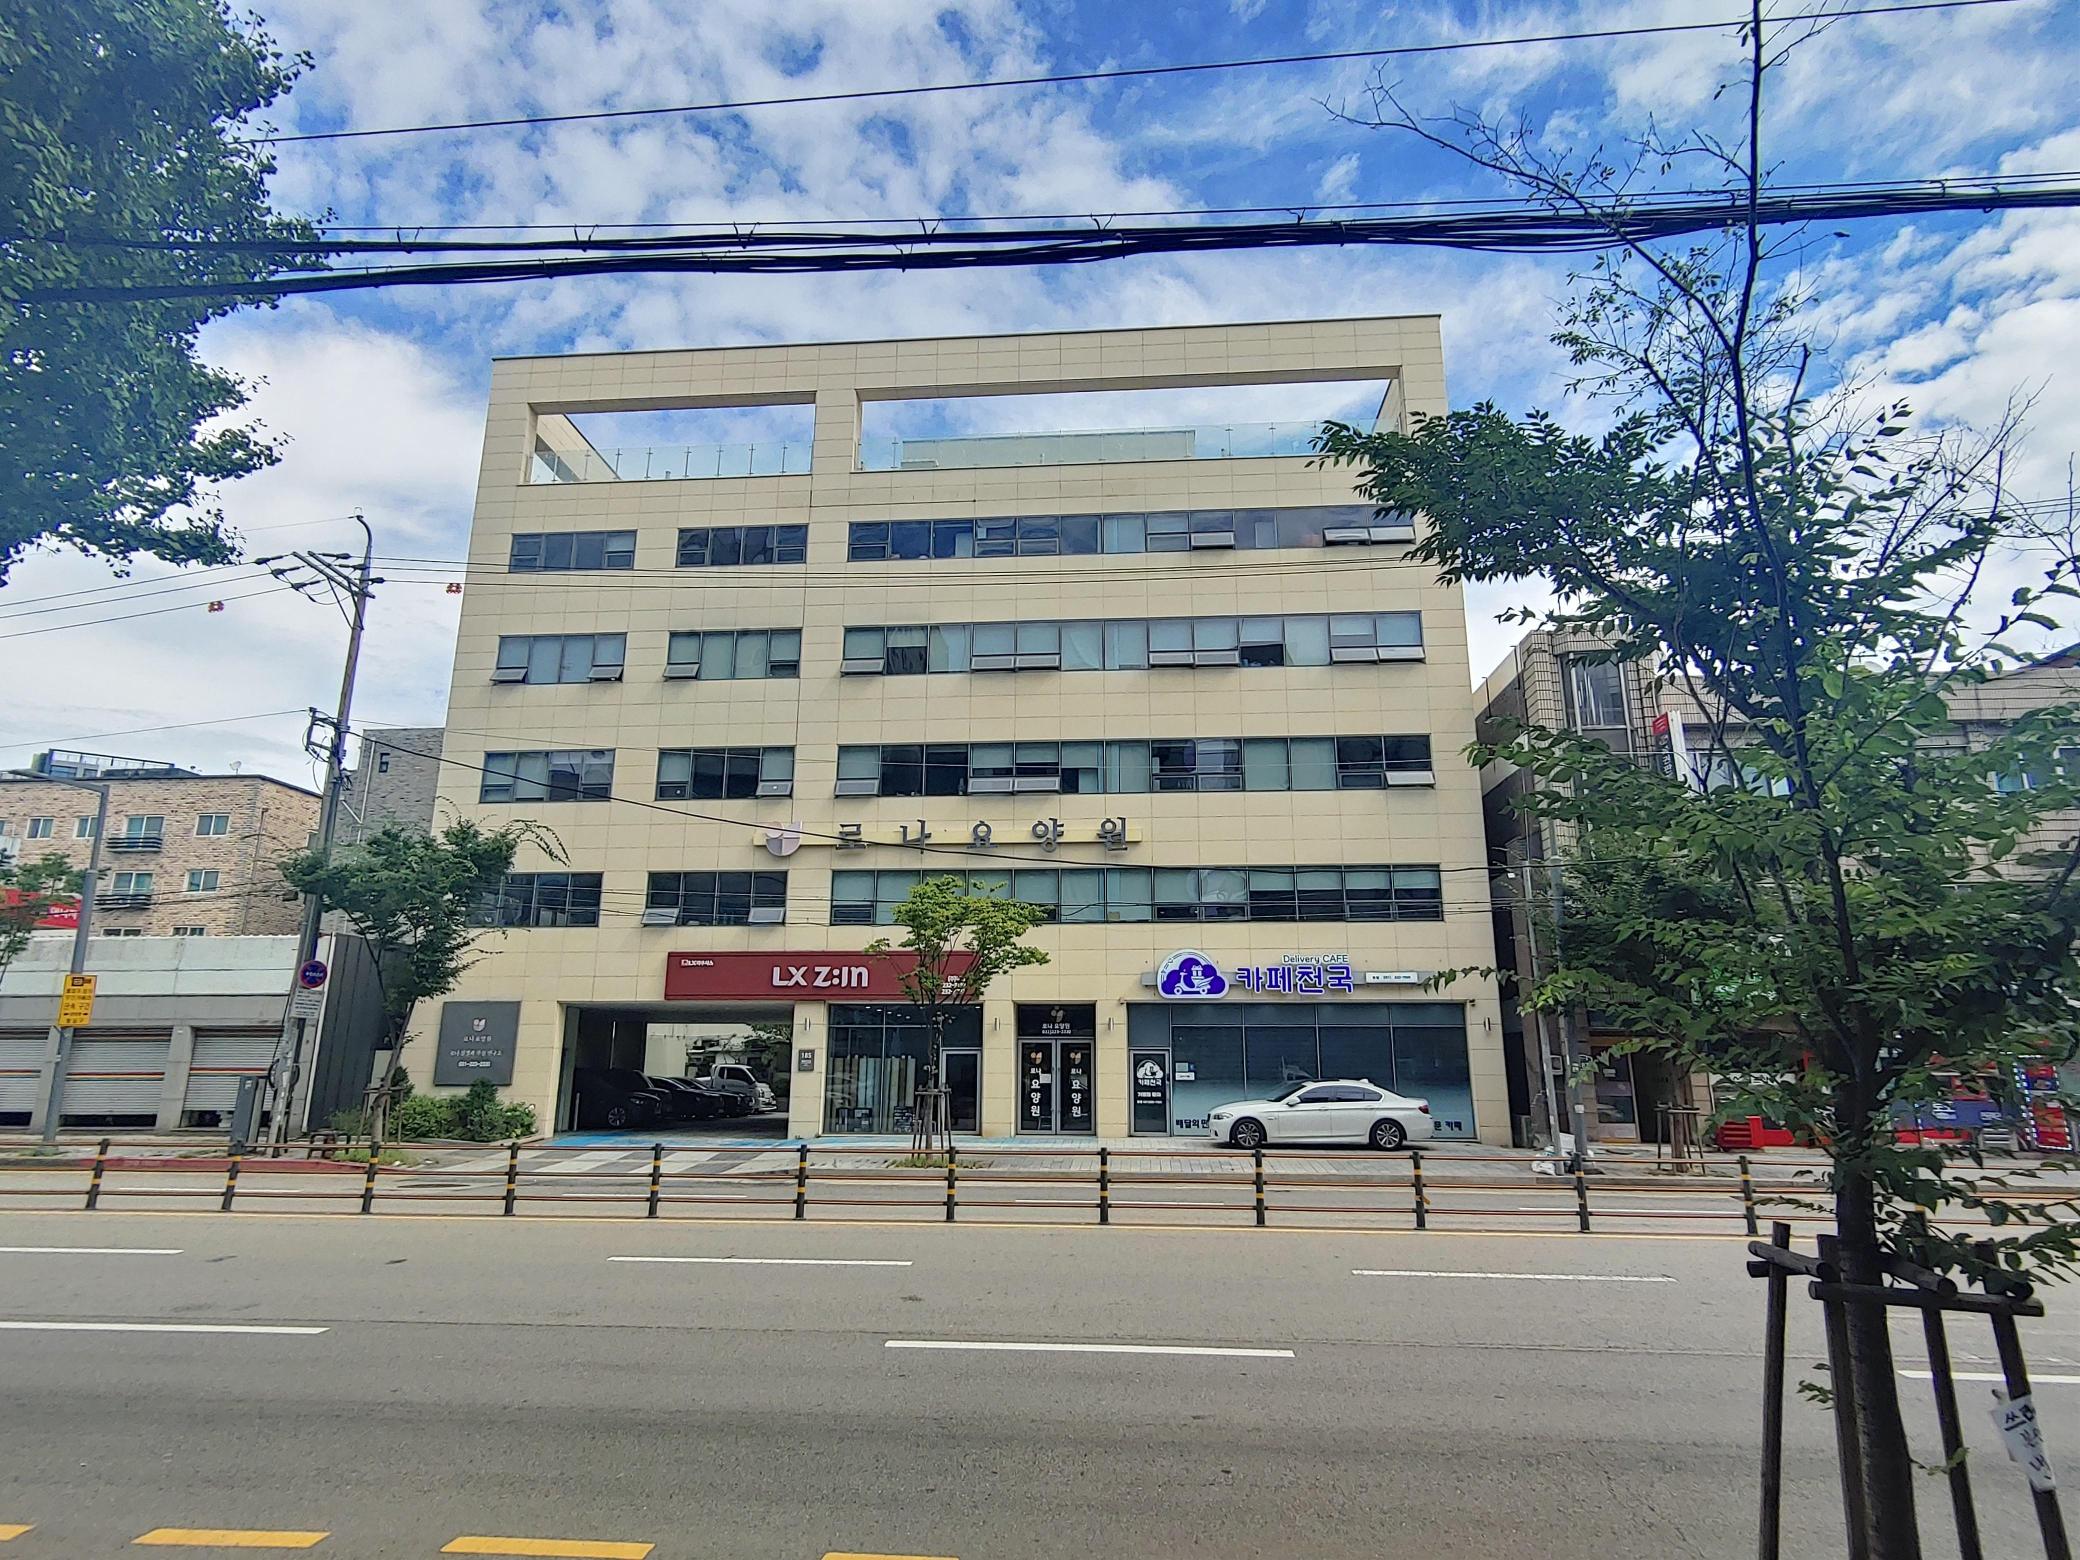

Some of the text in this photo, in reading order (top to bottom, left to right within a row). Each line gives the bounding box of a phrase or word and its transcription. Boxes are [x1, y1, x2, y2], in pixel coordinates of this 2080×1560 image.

[835, 816, 1128, 854] 로나요양원
[1282, 954, 1349, 964] Delivery CAFE
[772, 966, 808, 986] LX
[1236, 964, 1354, 994] 카페천국
[1030, 1067, 1042, 1075] 로나
[1070, 1067, 1082, 1075] 로나
[1030, 1079, 1041, 1117] 요양원
[1071, 1079, 1082, 1117] 요양원
